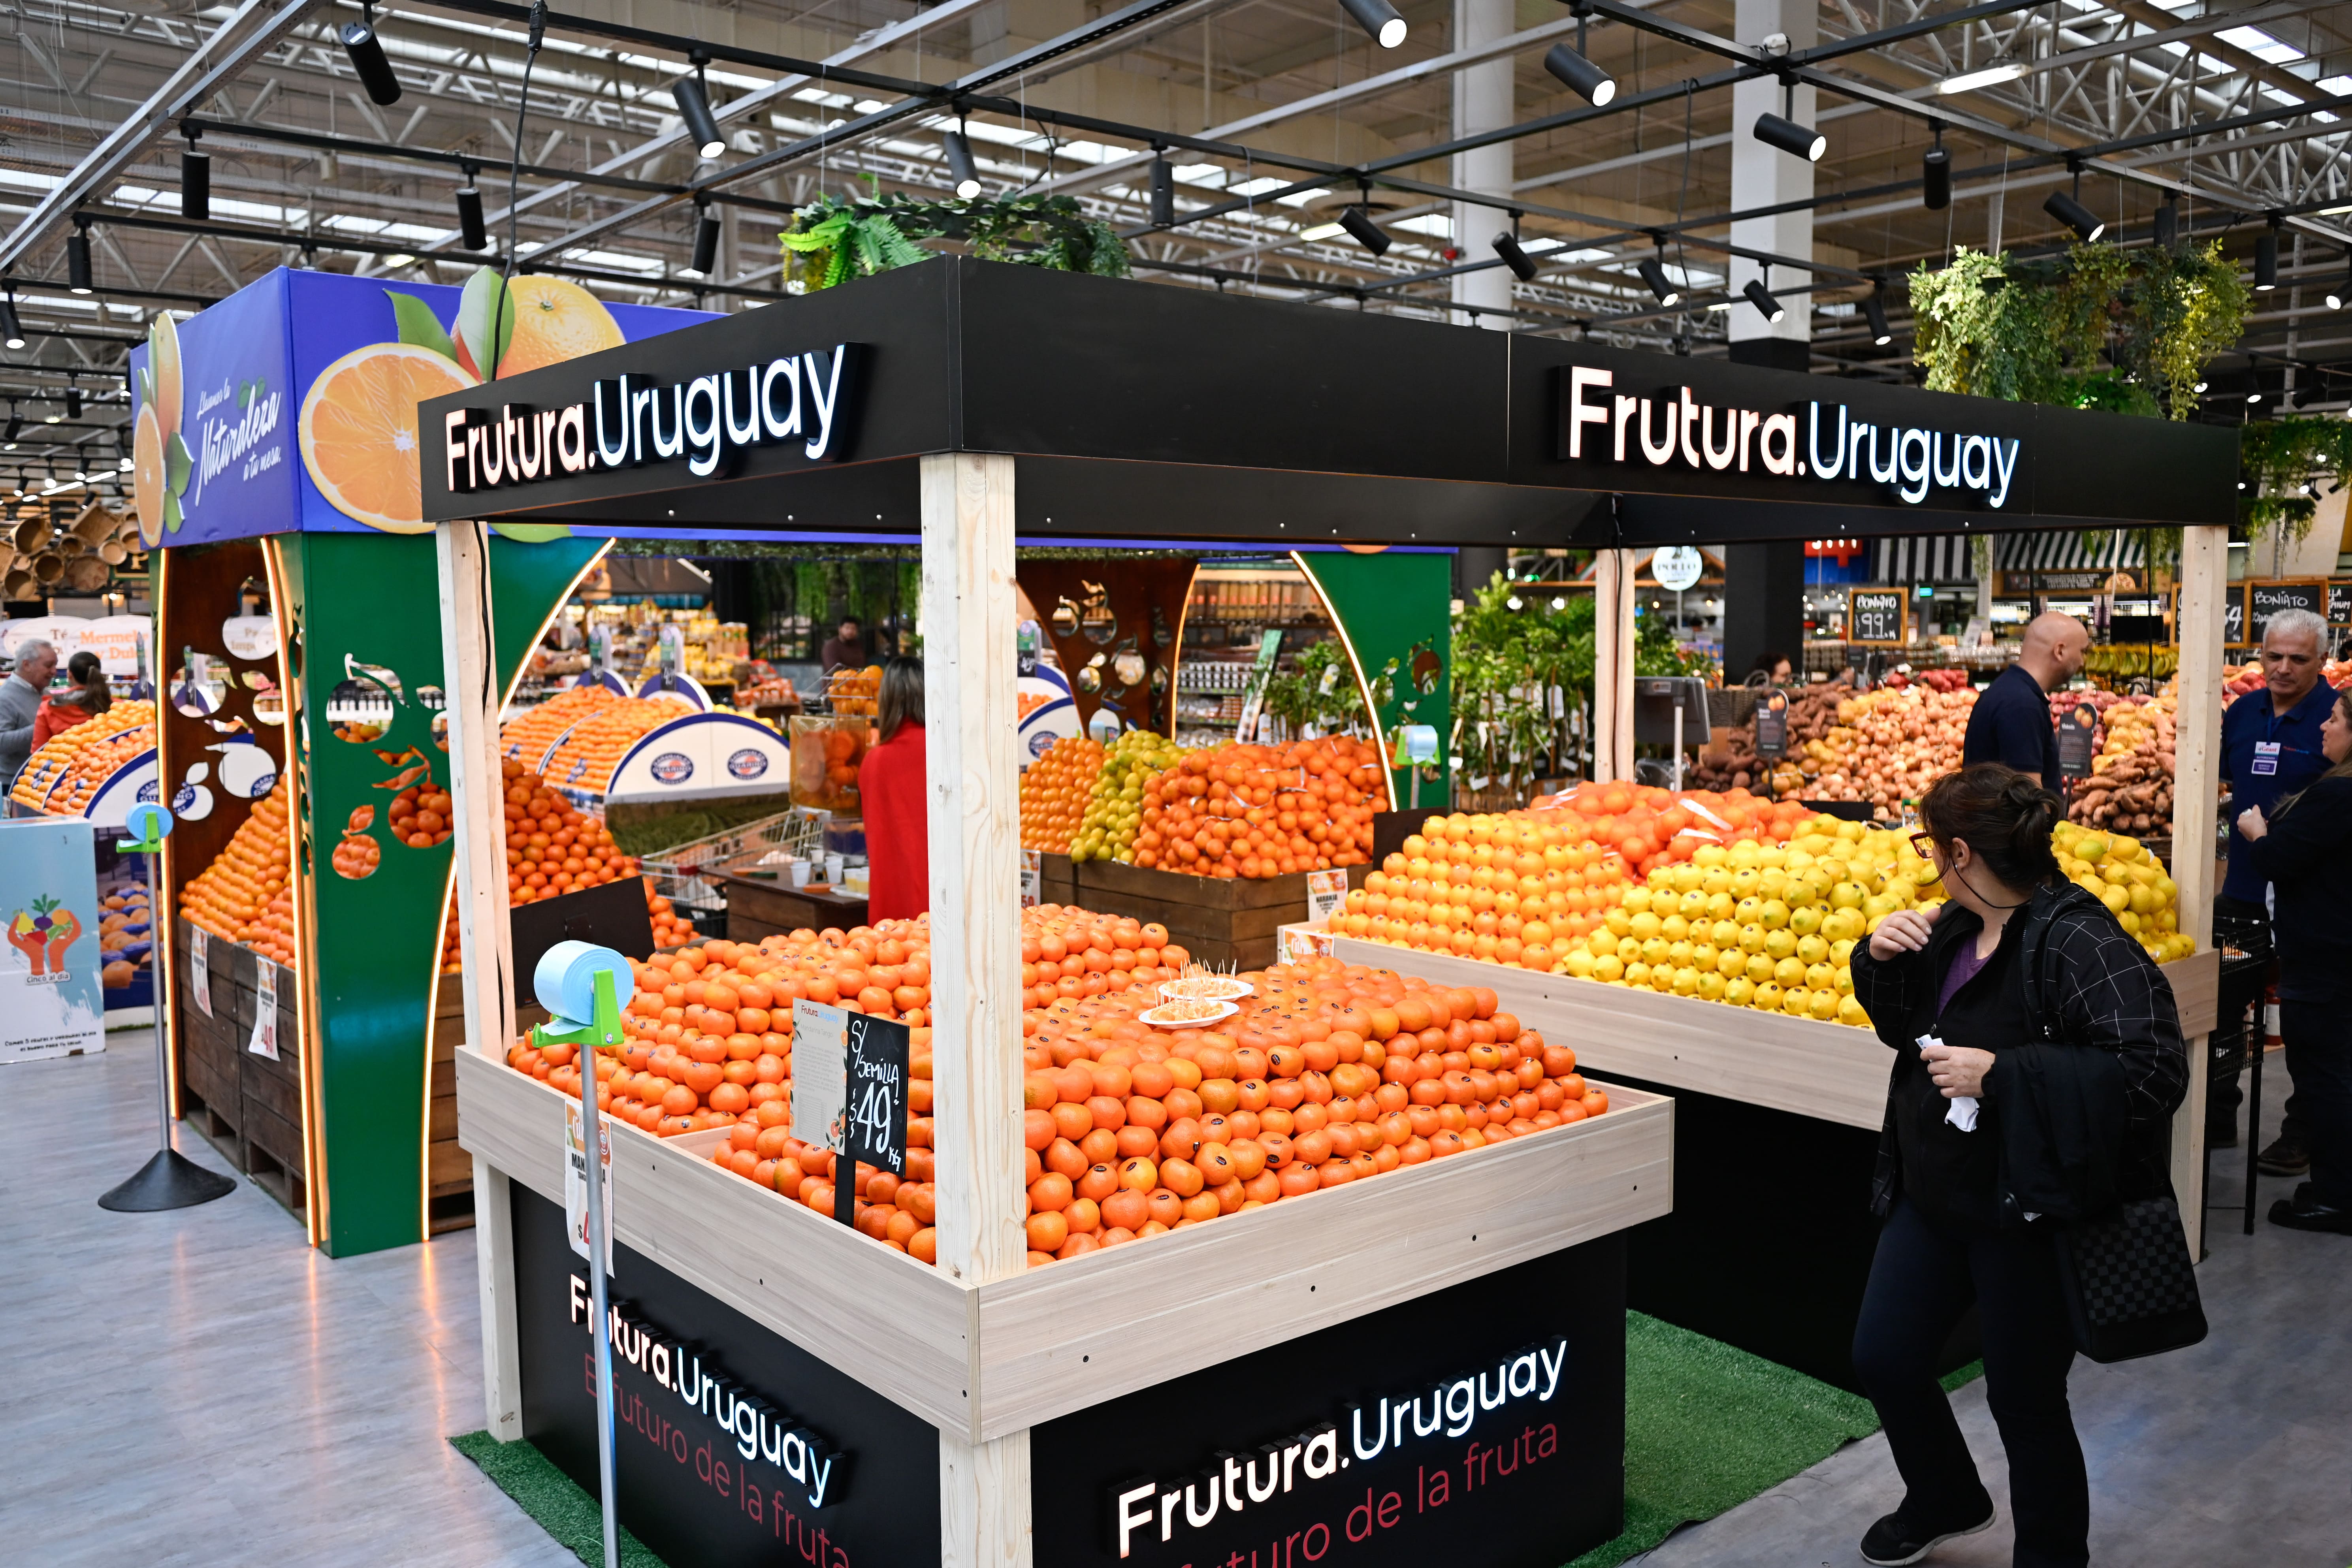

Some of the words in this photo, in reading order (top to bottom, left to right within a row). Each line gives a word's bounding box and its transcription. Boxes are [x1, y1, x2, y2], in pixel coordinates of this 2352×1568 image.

[195, 384, 281, 506] Naturaleza
[446, 344, 846, 492] Frutura.Uruguay
[1569, 365, 2020, 508] Frutura.Uruguay
[696, 1439, 730, 1497] de
[740, 1463, 763, 1525] la
[1119, 1340, 1567, 1559] Frutura.Uruguay
[1345, 1487, 1402, 1542] de
[1418, 1466, 1449, 1513] la
[1463, 1423, 1557, 1491] fruta
